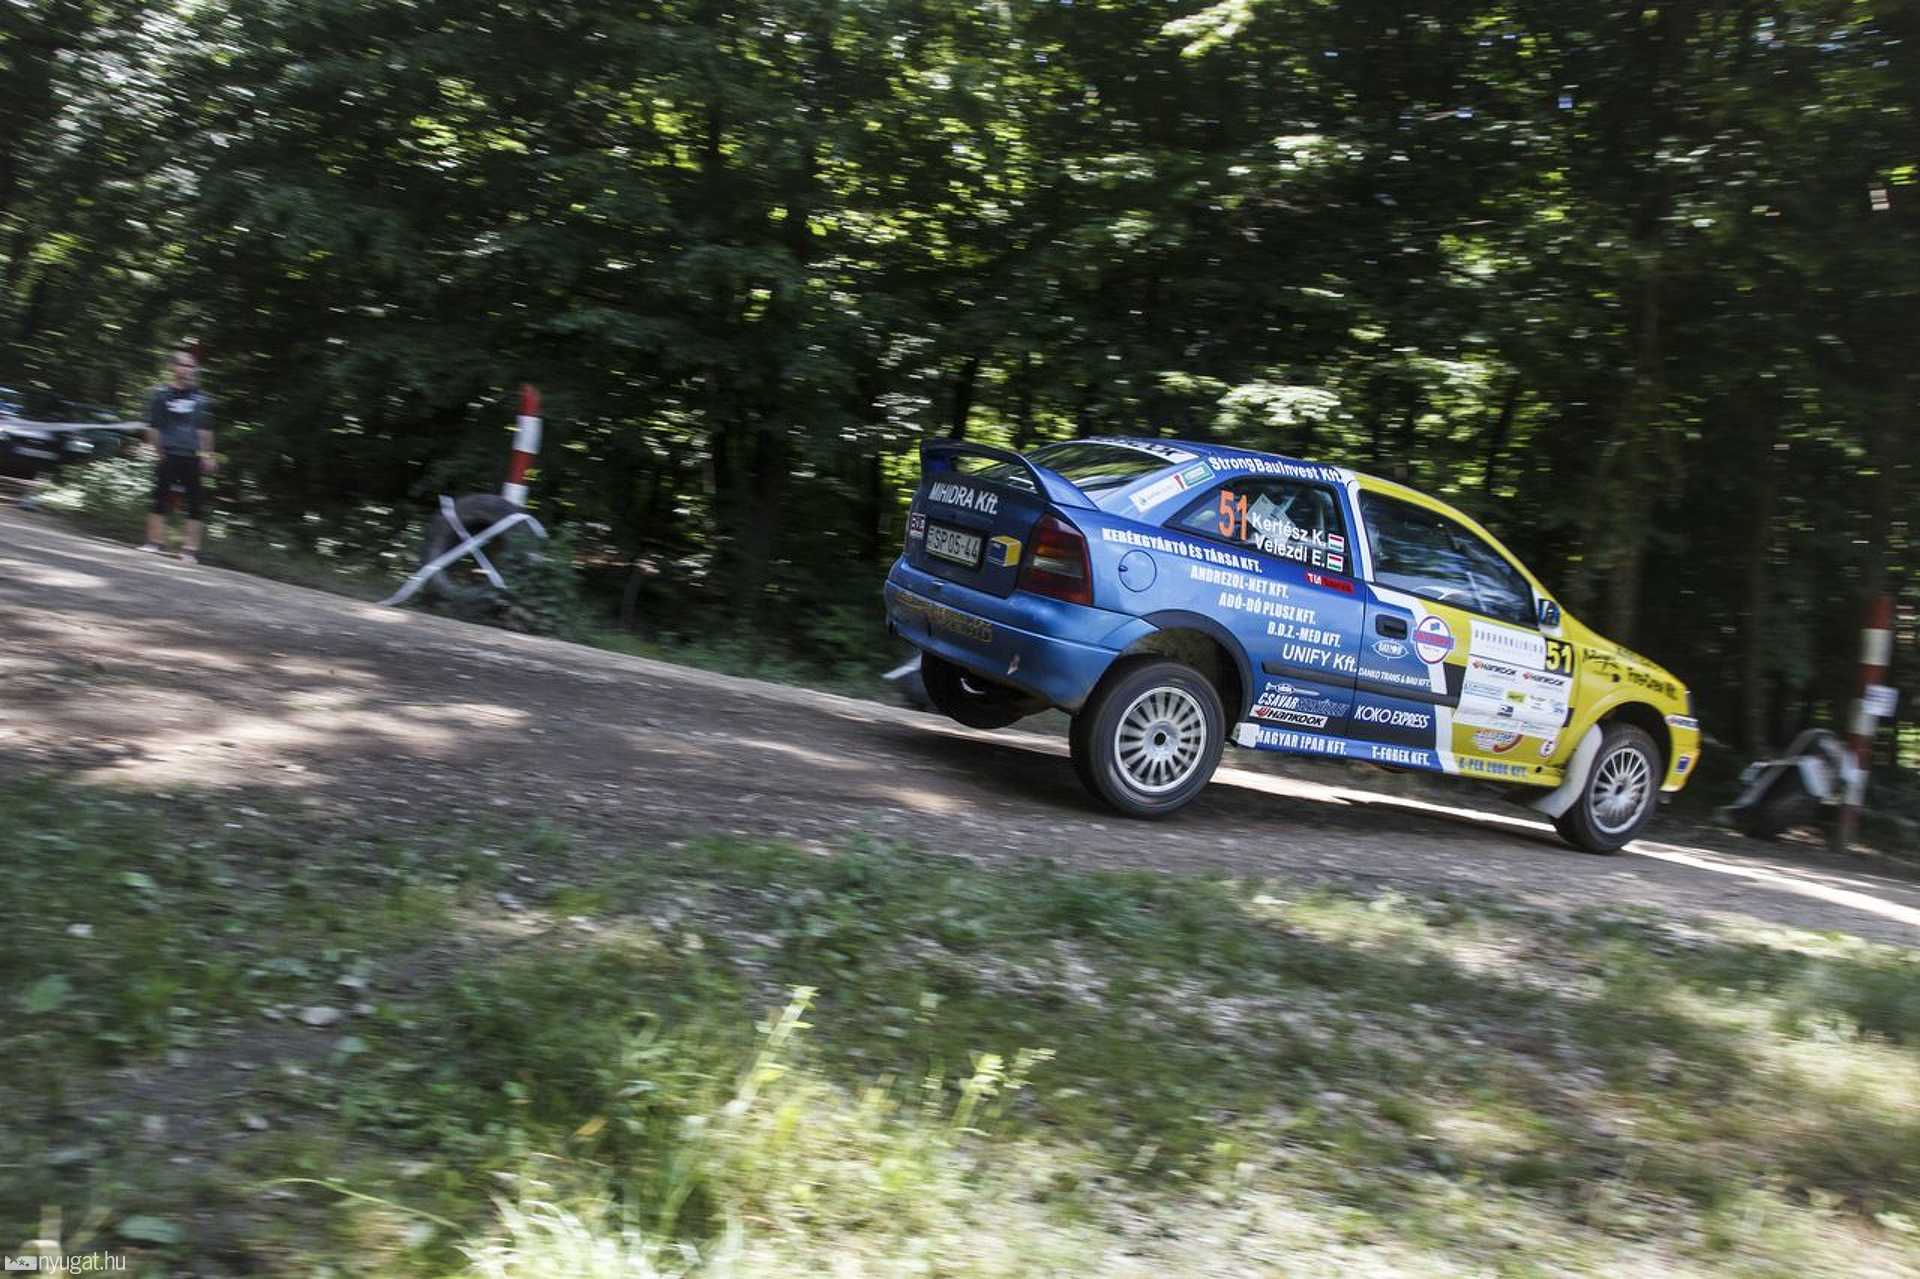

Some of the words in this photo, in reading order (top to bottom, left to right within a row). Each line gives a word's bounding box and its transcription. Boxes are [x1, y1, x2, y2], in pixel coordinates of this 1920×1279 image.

[1218, 489, 1248, 541] 51
[1312, 549, 1325, 567] E.
[1282, 644, 1331, 666] UNIFY
[1332, 653, 1357, 673] Kft.
[1546, 641, 1572, 674] 51
[1354, 705, 1391, 723] KOKO
[1390, 711, 1431, 729] EXPRESS
